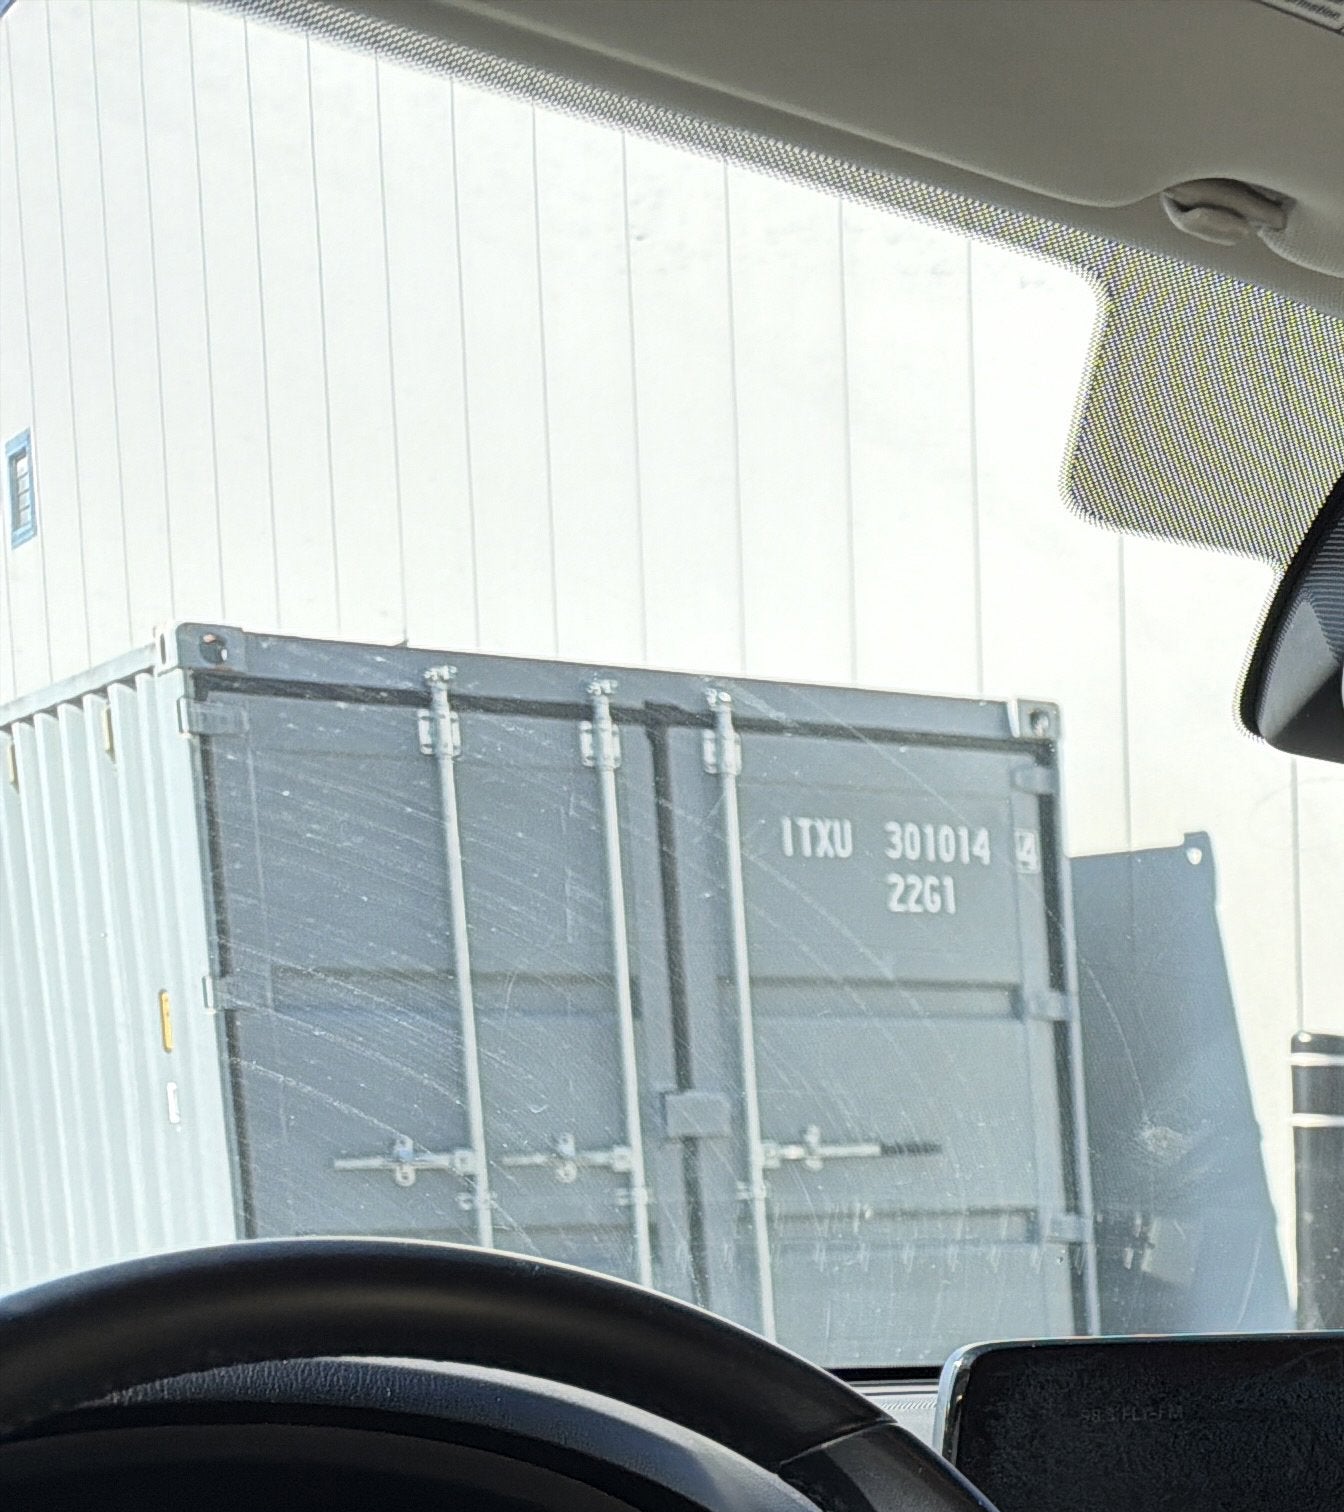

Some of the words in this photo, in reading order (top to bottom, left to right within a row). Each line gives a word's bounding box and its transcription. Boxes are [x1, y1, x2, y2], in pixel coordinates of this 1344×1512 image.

[780, 815, 852, 858] ITXU
[884, 821, 991, 866] 301014
[885, 872, 956, 914] 22G1
